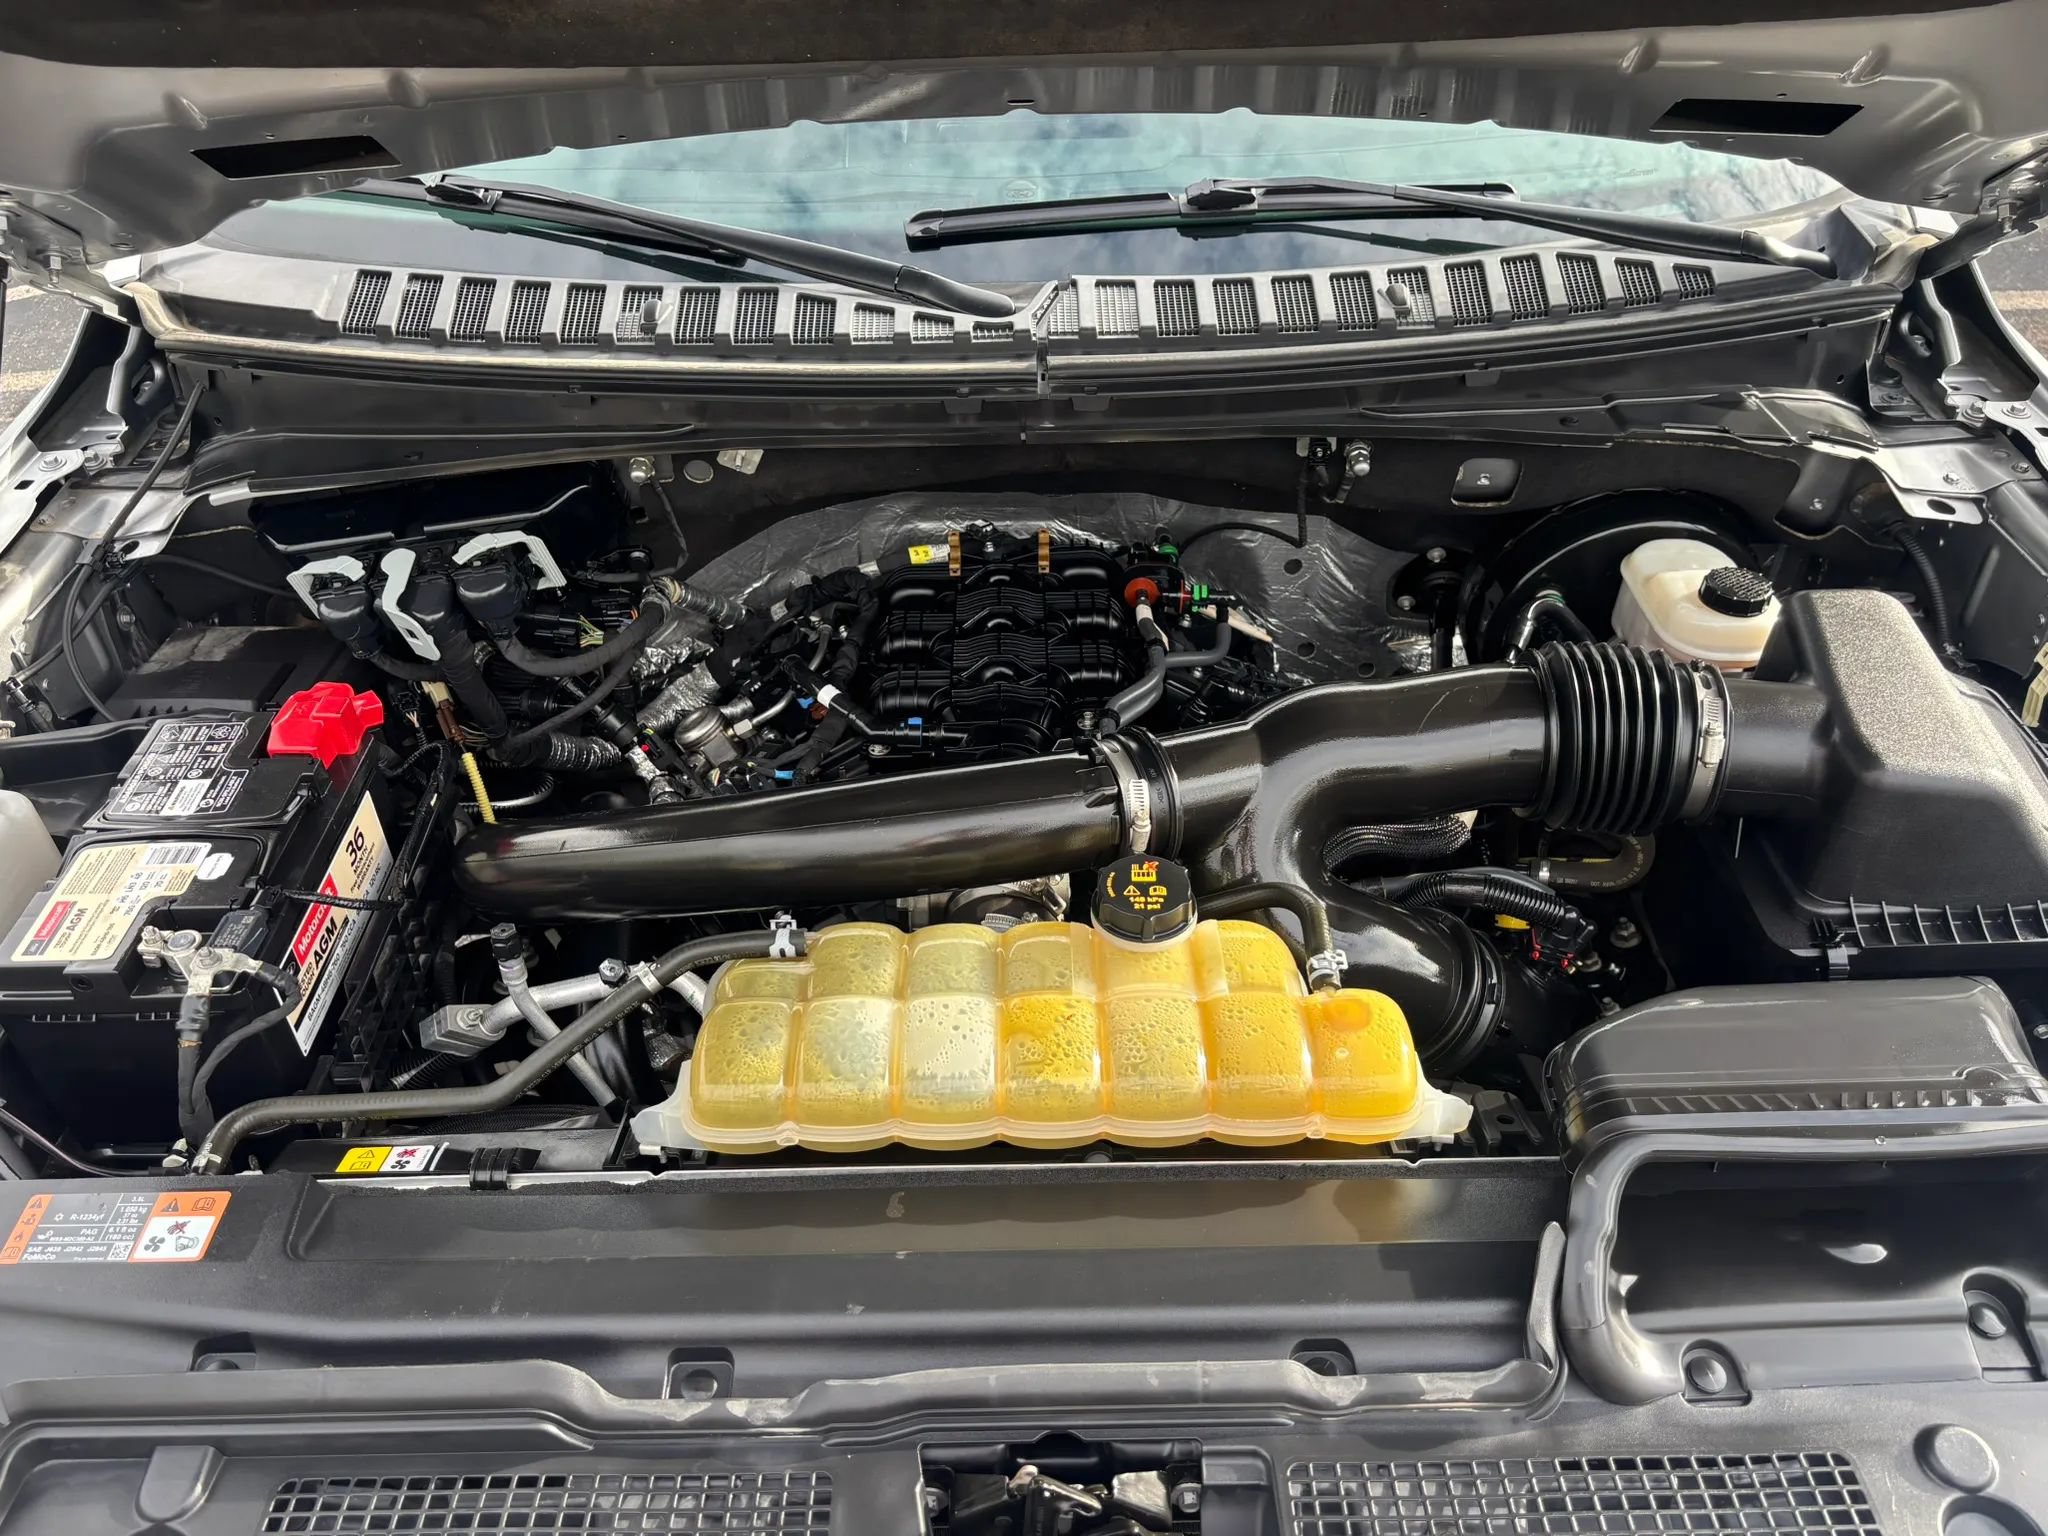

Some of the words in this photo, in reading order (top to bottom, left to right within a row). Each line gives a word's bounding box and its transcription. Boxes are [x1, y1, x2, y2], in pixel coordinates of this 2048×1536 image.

[345, 826, 365, 867] 36
[353, 845, 368, 876] MONTH
[66, 908, 89, 931] AGM
[298, 887, 334, 956] Motorcrt
[312, 916, 338, 970] AGM
[69, 1213, 105, 1221] R-1234yf
[138, 1206, 148, 1214] kg
